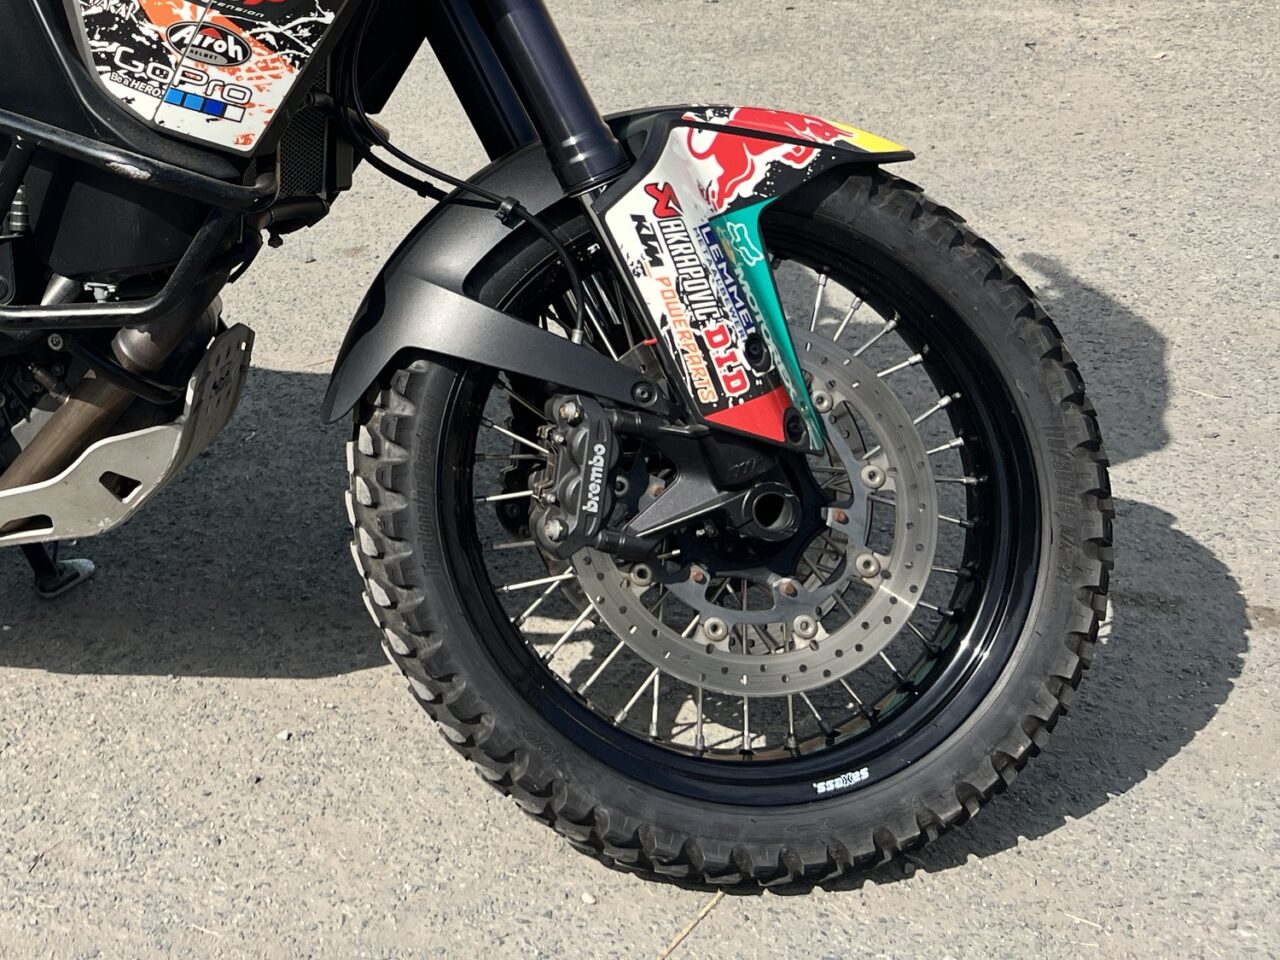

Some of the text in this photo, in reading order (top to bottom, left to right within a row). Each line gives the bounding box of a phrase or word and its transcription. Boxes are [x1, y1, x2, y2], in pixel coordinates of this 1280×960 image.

[110, 71, 122, 83] Be
[113, 45, 253, 106] GoPro
[170, 25, 244, 61] Airoh
[630, 214, 719, 406] KTM POWERPARTS
[698, 224, 758, 336] LEMME
[734, 267, 797, 398] MOTOREX
[582, 443, 606, 513] brembo
